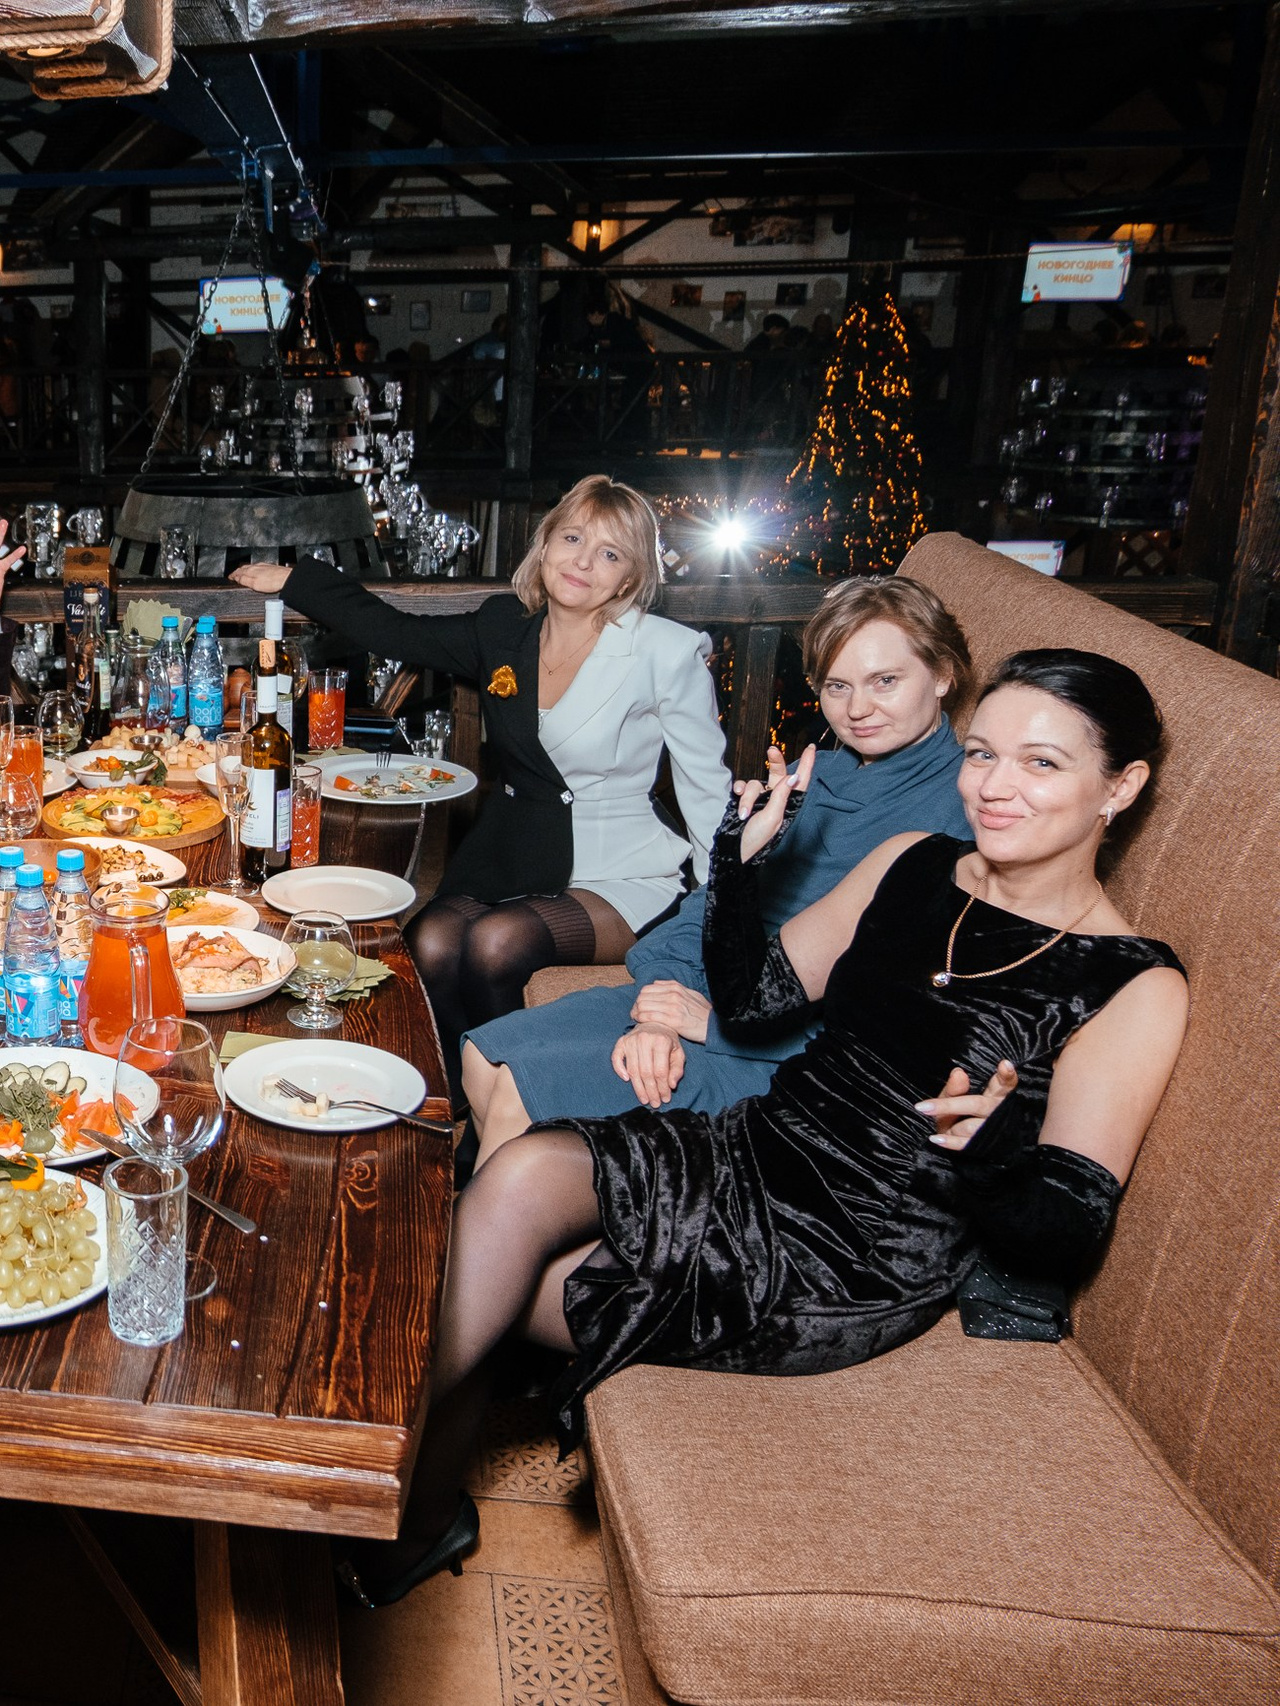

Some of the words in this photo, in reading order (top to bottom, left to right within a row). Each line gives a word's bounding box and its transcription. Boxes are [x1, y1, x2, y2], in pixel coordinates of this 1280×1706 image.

[1037, 260, 1114, 270] НОВОГОДНЕЕ
[1053, 274, 1094, 284] КИНЦО
[214, 294, 281, 305] НОВОГОДЕЕ
